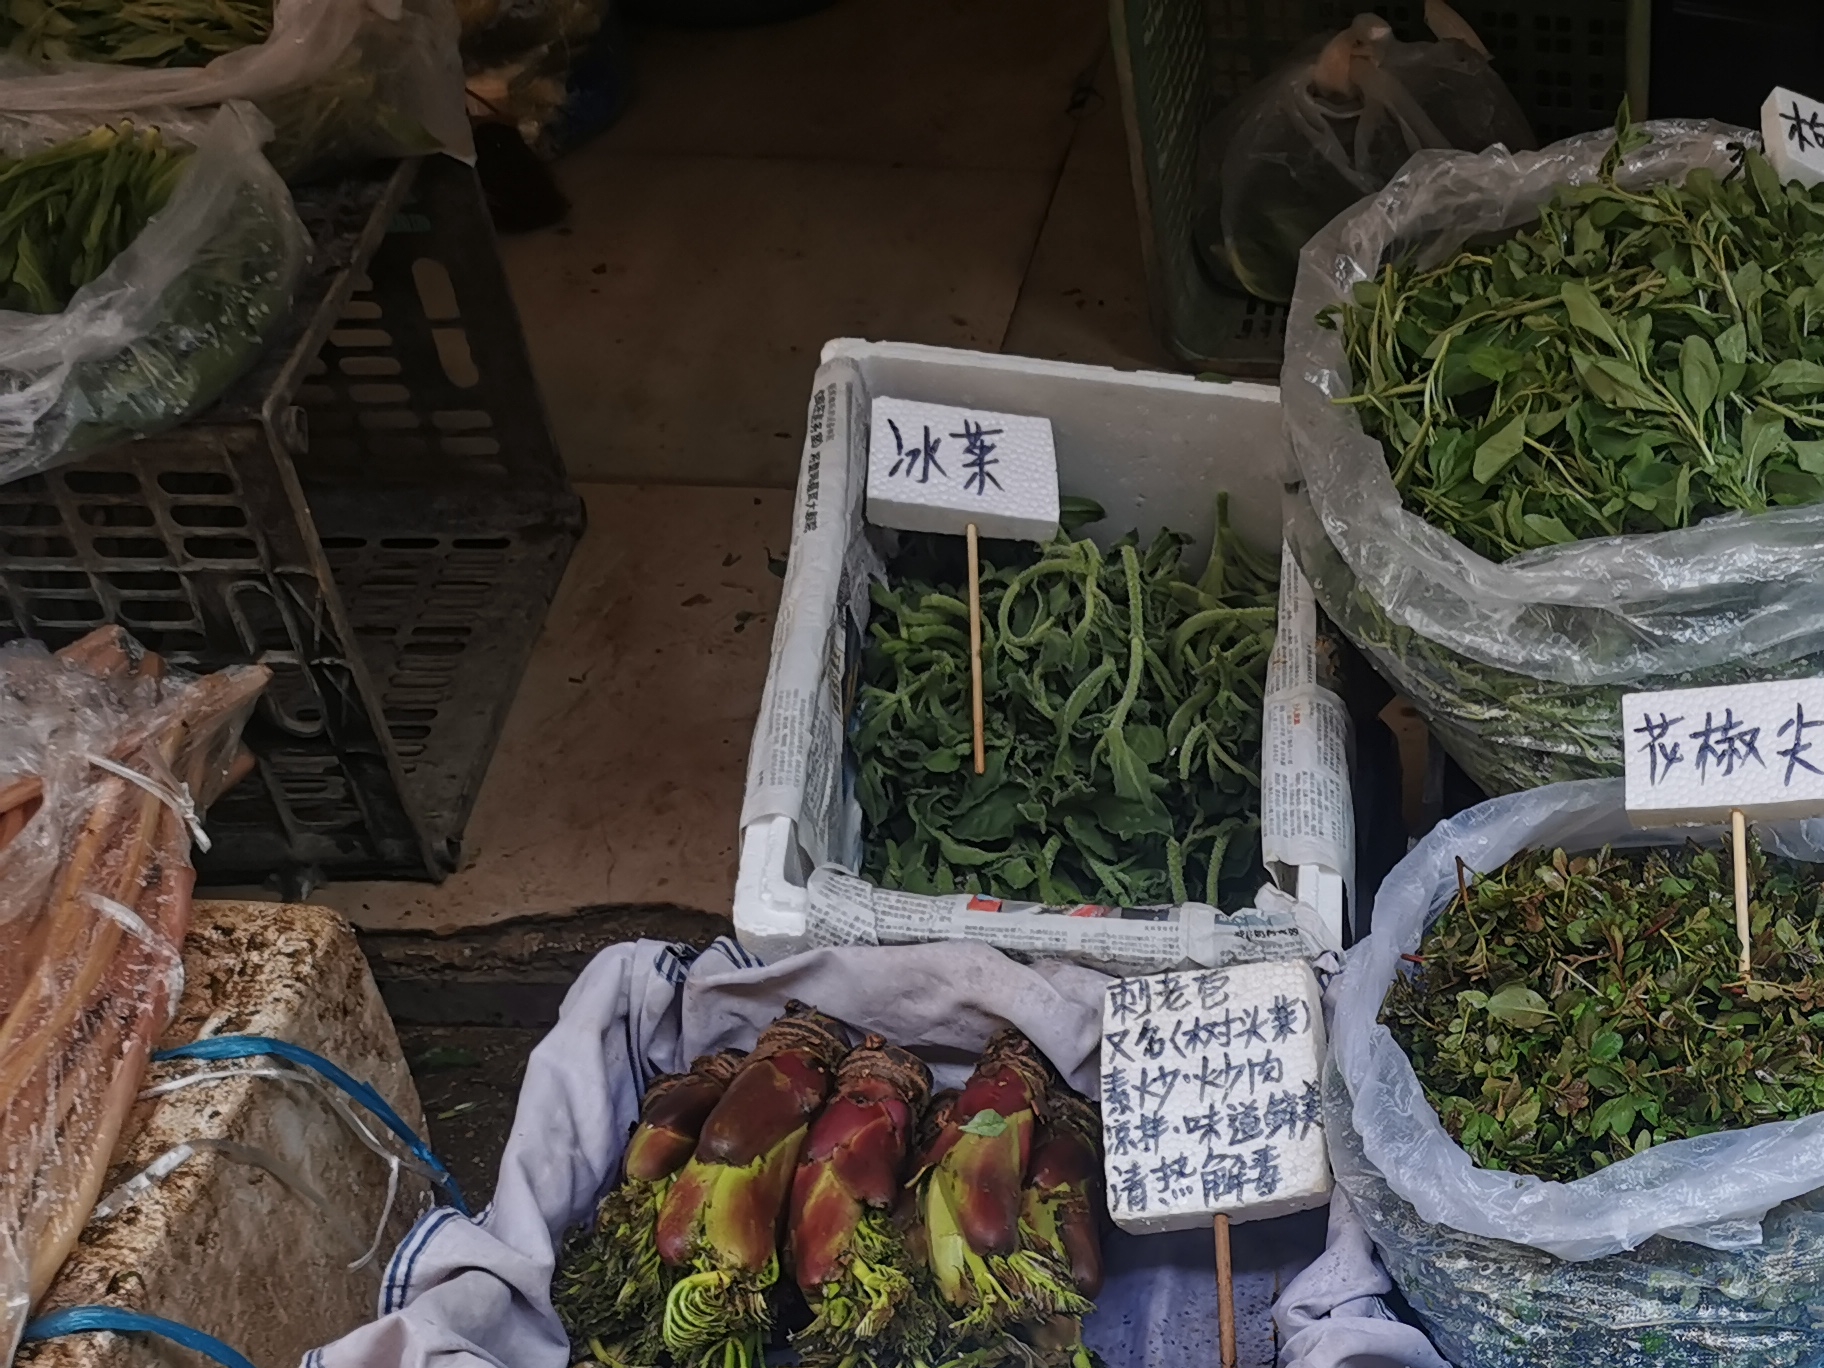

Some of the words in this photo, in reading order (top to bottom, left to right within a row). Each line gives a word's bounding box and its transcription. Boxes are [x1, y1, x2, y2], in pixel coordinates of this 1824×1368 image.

[887, 418, 1005, 495] 冰菜
[1110, 1144, 1283, 1212] 清热解毒
